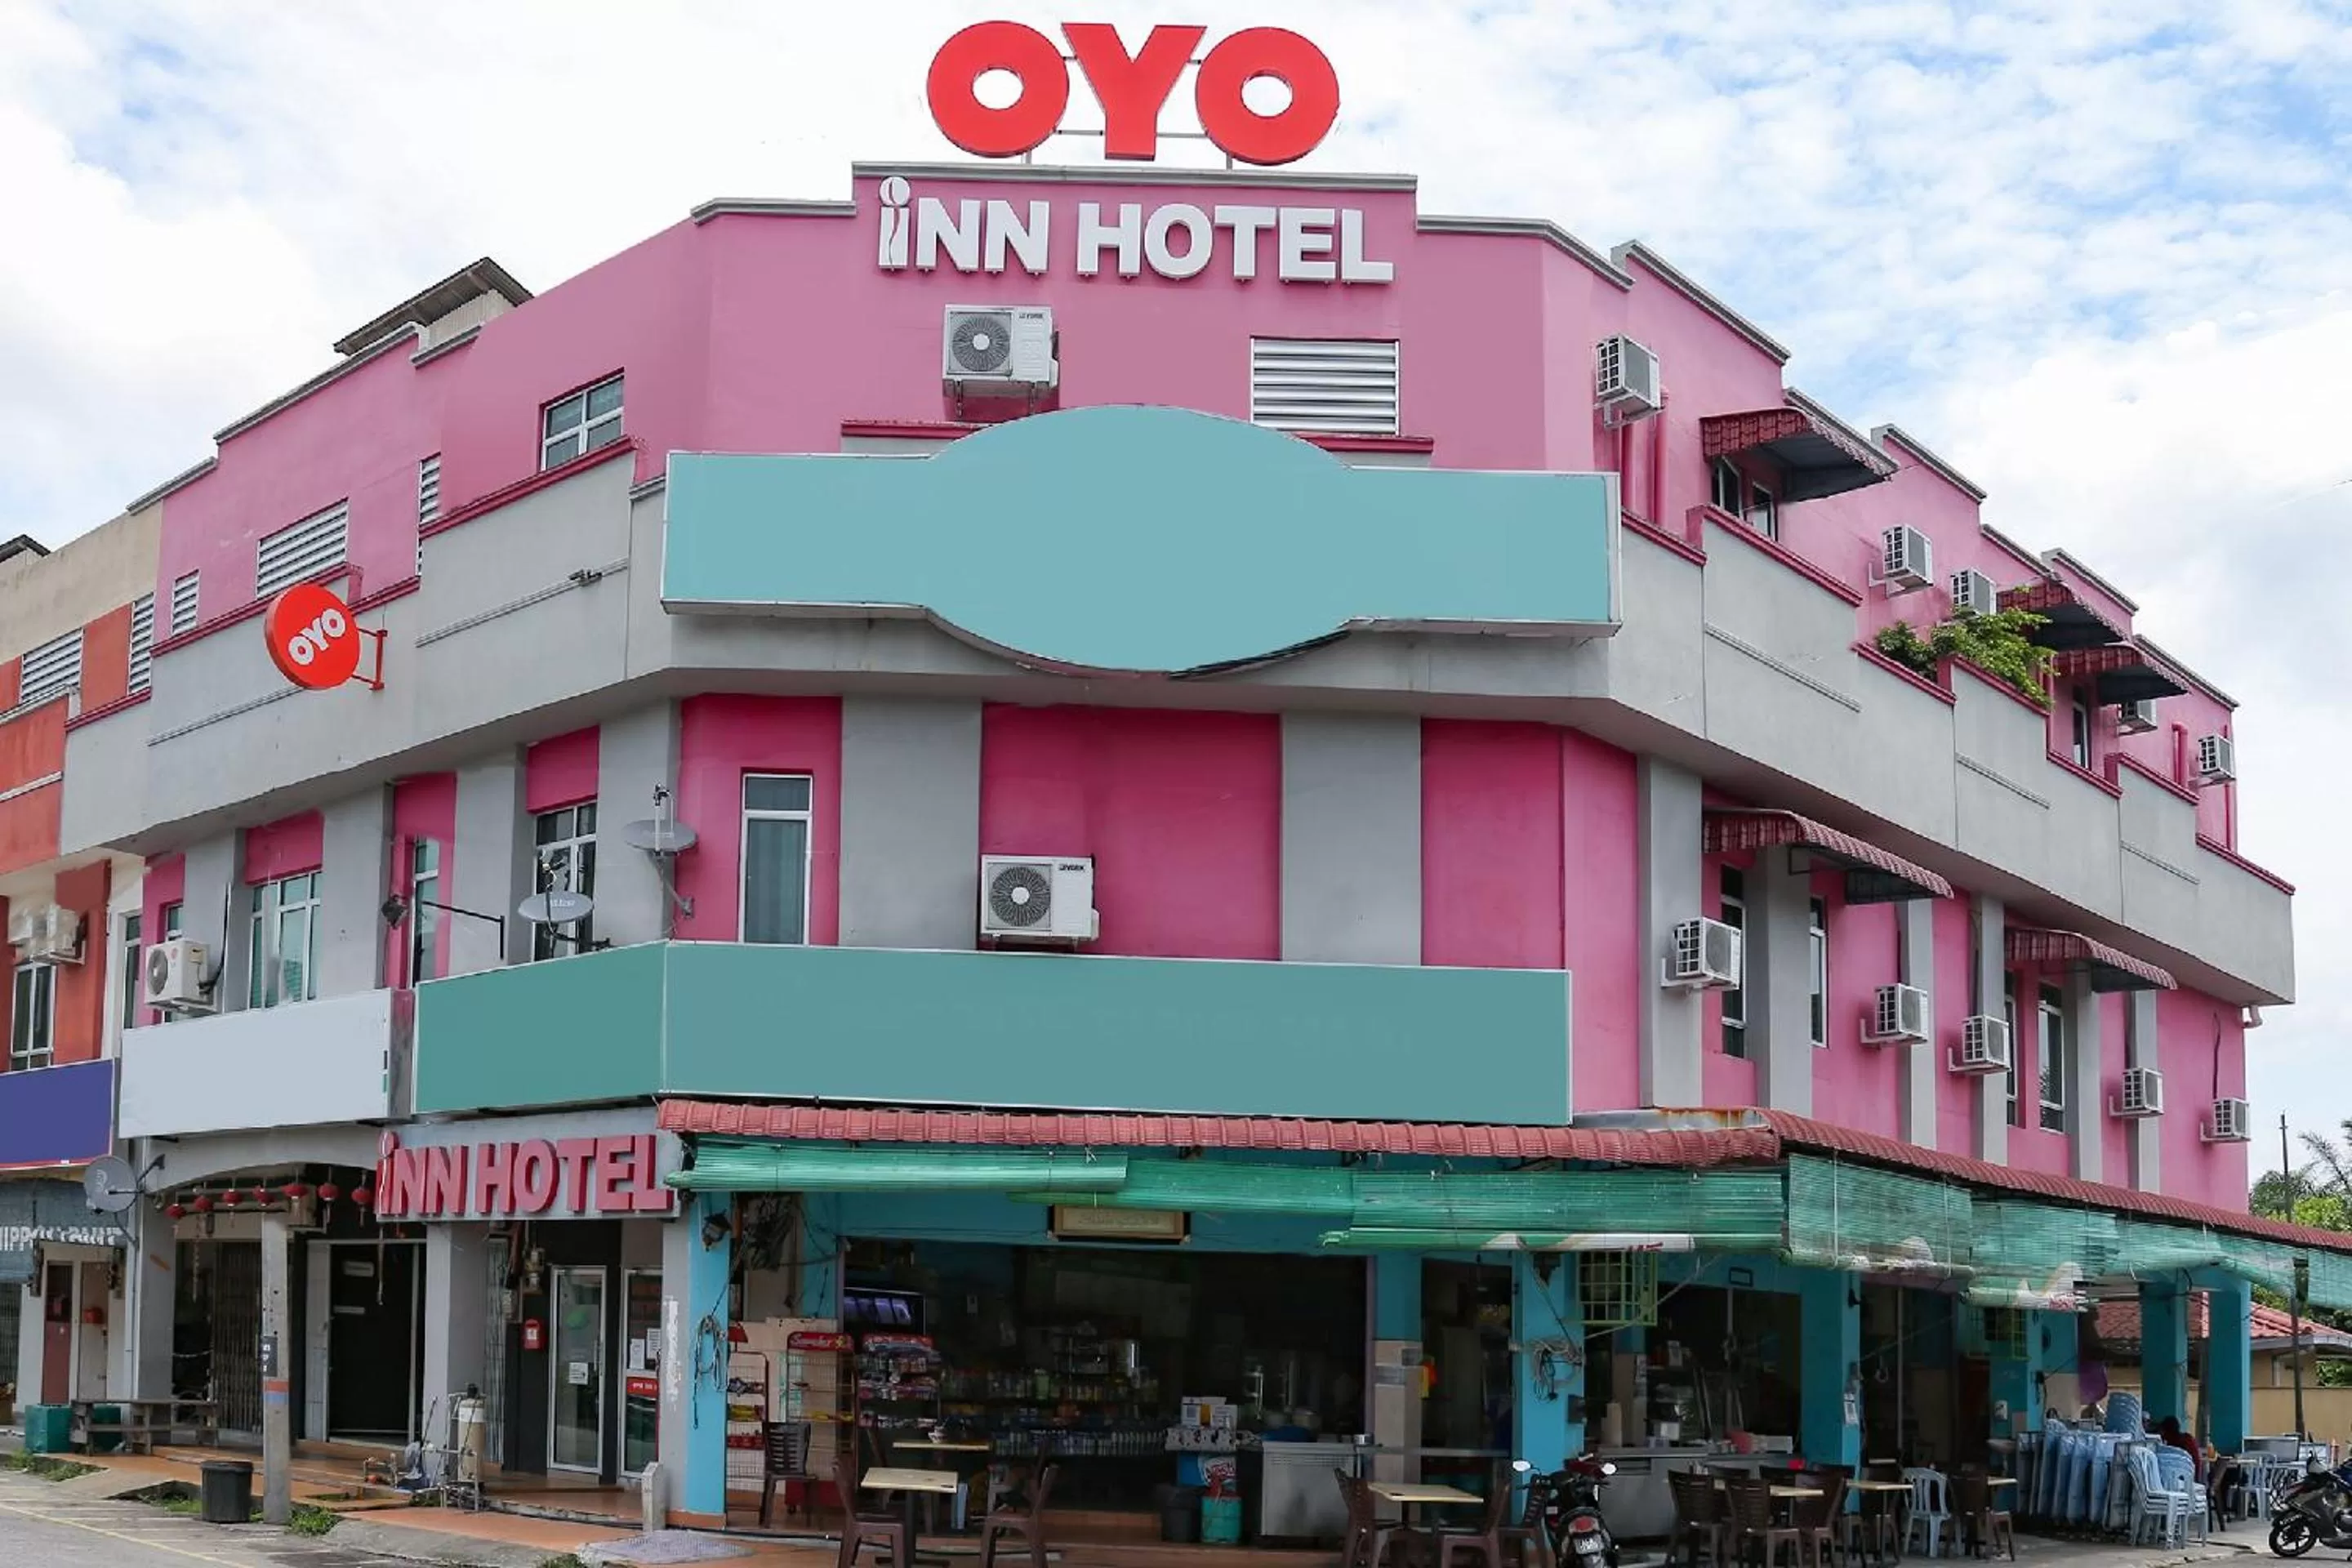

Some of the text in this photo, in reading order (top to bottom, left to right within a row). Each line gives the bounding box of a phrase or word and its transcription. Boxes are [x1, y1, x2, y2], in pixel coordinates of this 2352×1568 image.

[927, 20, 1339, 166] OYO
[1076, 203, 1393, 283] HOTEL
[288, 608, 345, 666] OYO
[474, 1134, 674, 1214] HOTEL
